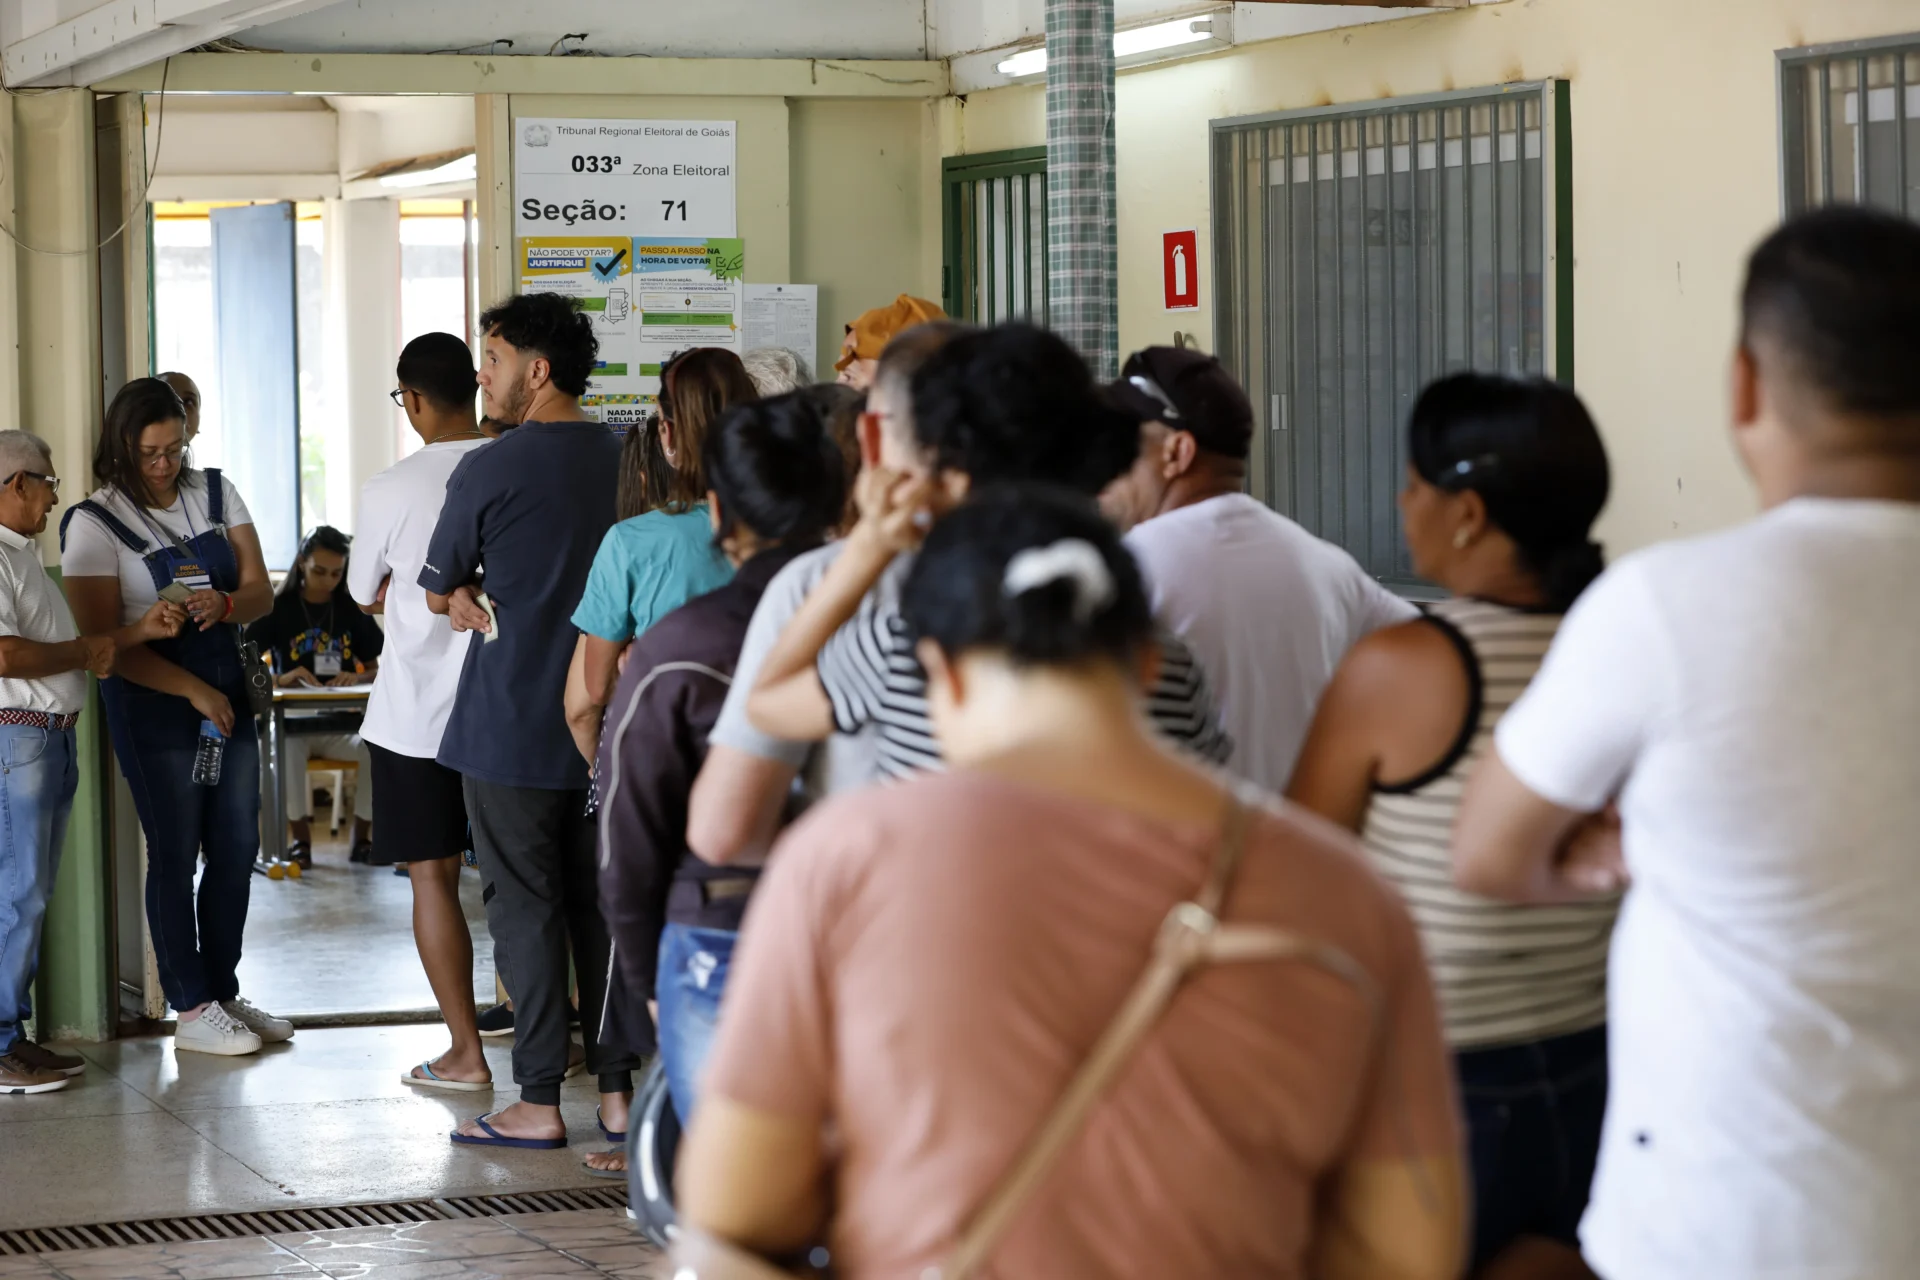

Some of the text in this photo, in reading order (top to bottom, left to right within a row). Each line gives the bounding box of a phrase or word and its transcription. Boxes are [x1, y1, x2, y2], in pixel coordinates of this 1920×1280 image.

[557, 126, 730, 138] Tribunal Regional Eleitoral de Goiás
[571, 155, 730, 176] 033ª Zona Eleitoral
[522, 198, 687, 226] Seção: 71
[529, 248, 612, 257] NÃO PODE VOTAR?
[529, 258, 584, 268] JUSTIFIQUE
